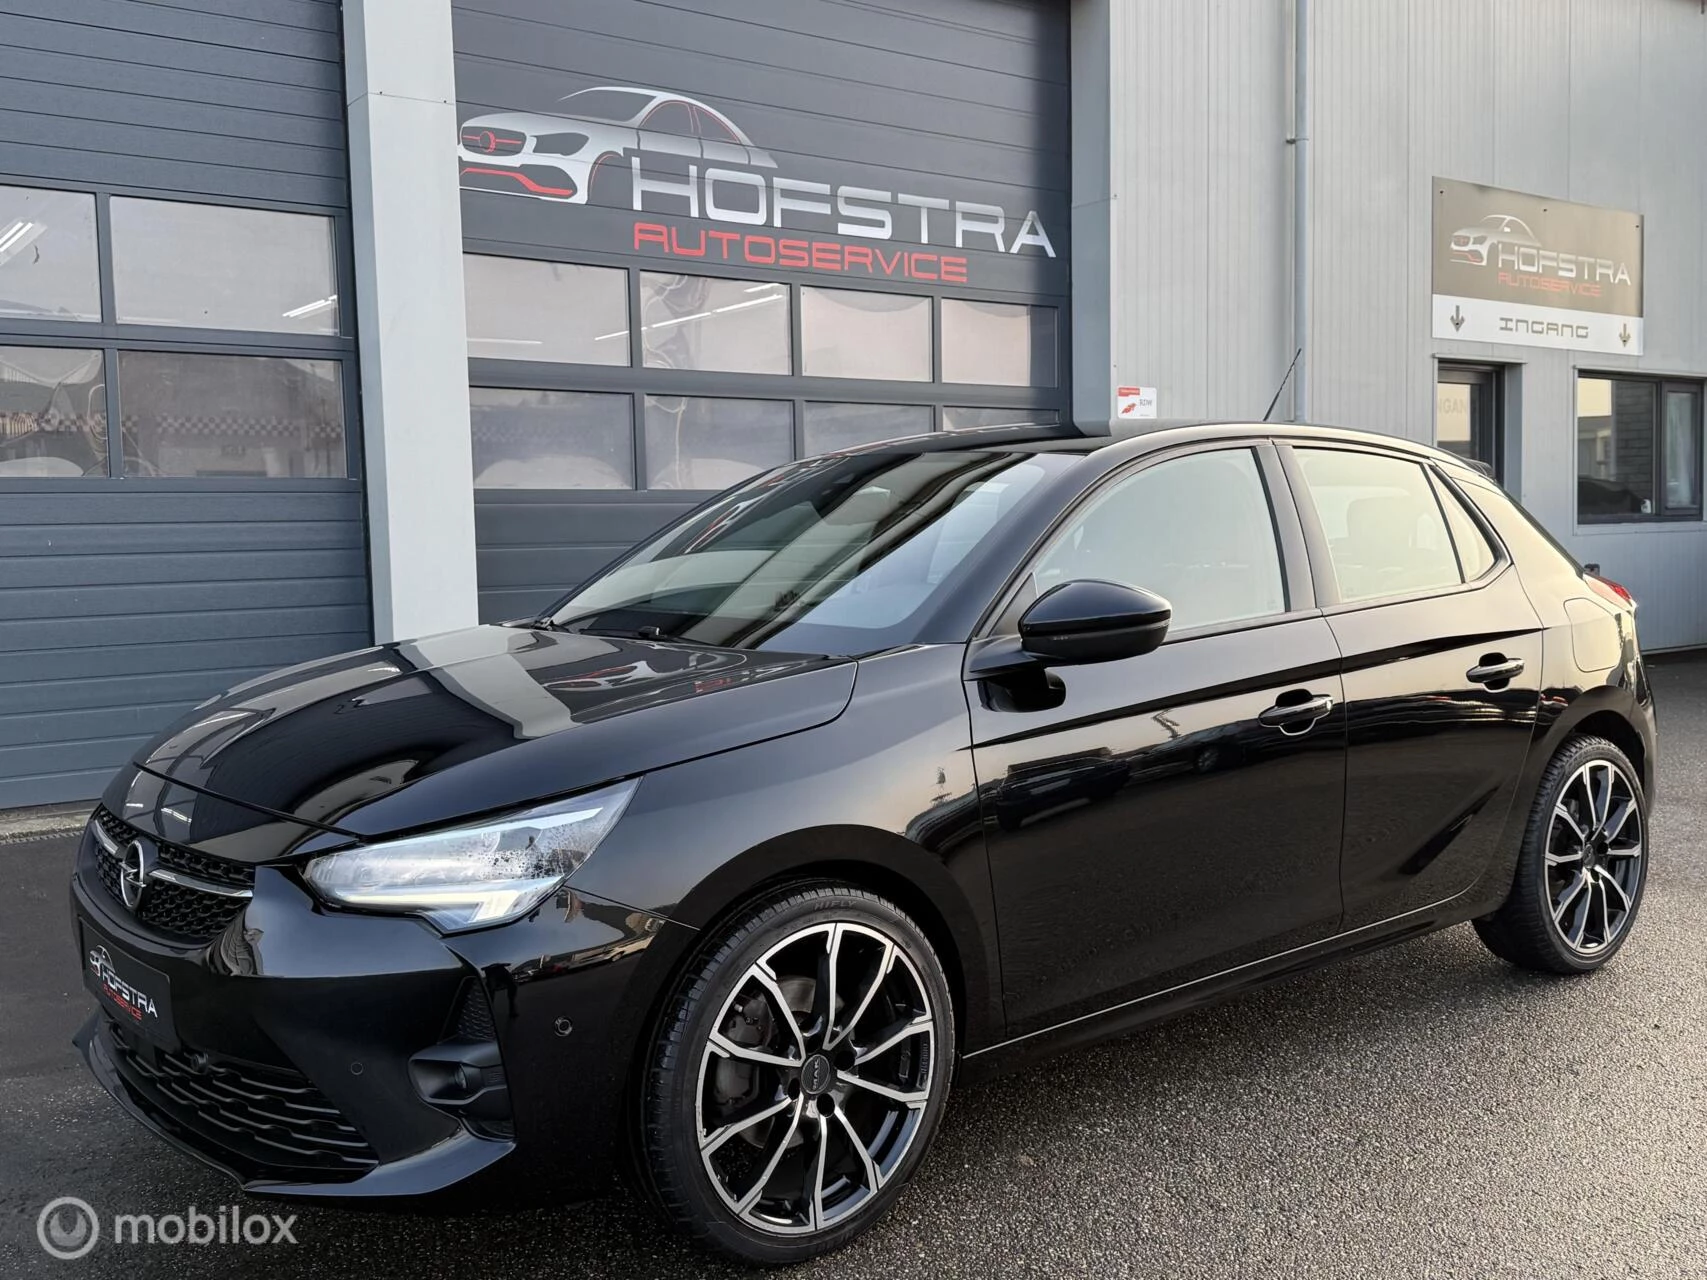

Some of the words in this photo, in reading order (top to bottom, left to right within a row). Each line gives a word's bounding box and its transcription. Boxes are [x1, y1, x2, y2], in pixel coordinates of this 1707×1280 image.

[631, 156, 1057, 259] HOFSTRA
[633, 222, 968, 283] AUTOSERVICE
[1498, 243, 1632, 286] HOFSTRA
[1498, 272, 1602, 297] AUTOSERVICE
[1499, 317, 1589, 339] INGANG
[814, 900, 857, 911] HIFLY
[102, 964, 158, 1018] HOFSTRA
